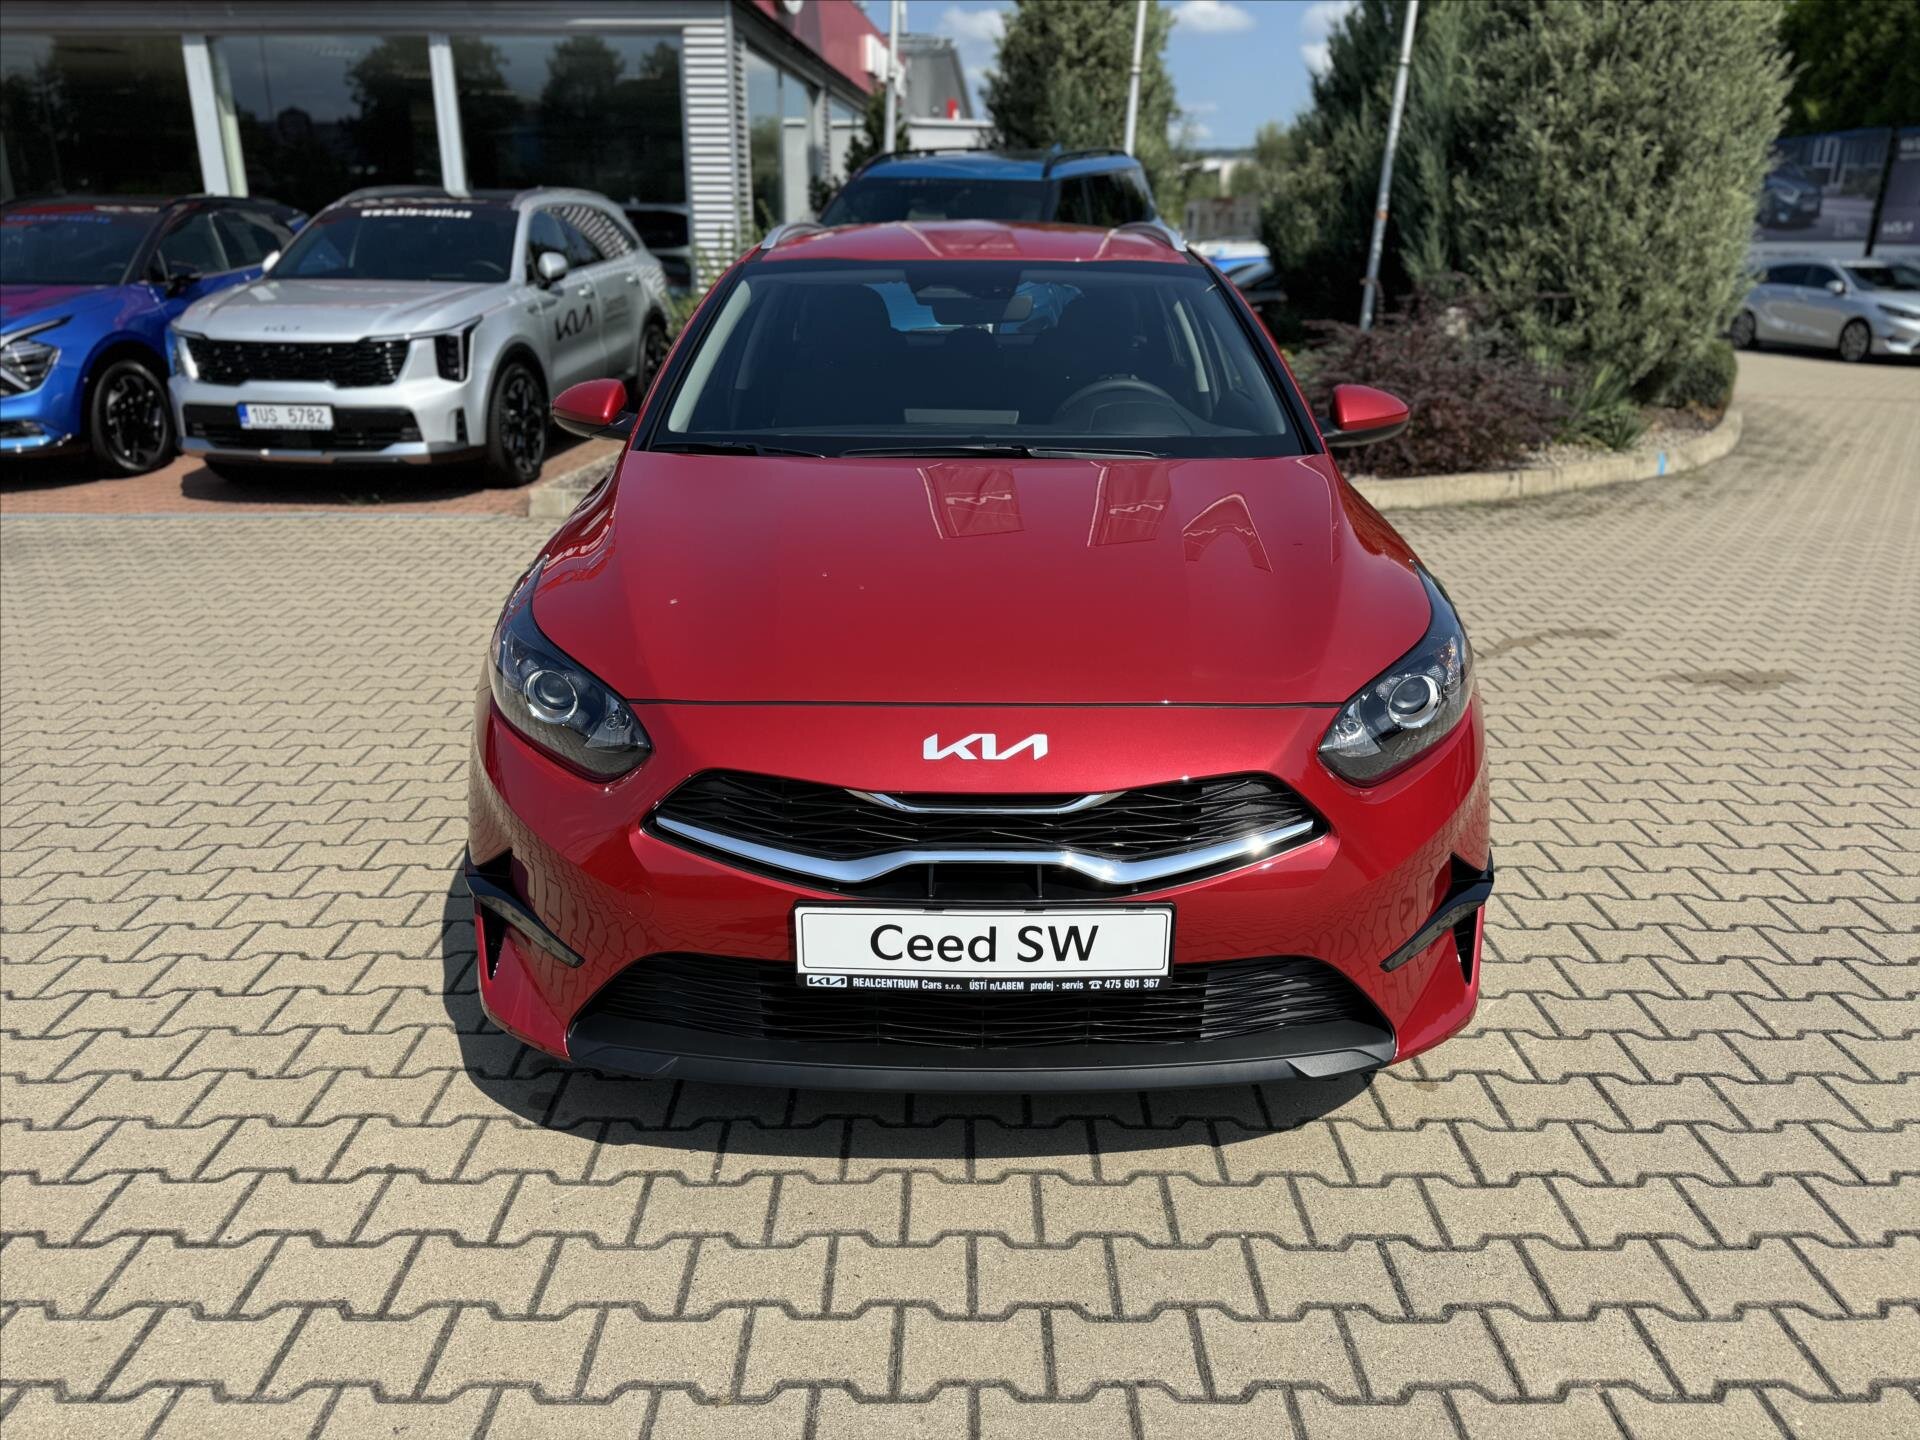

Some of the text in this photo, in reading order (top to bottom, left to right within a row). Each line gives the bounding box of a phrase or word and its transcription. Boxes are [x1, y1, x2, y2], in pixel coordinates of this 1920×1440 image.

[251, 407, 326, 425] 1US 5782
[923, 733, 1048, 760] KIA
[870, 924, 1099, 962] Ceed SW
[808, 976, 846, 987] KIA
[852, 977, 919, 990] REALCENTRUM
[921, 979, 942, 990] Cars
[944, 983, 963, 991] s.r.o.
[969, 979, 987, 991] ÚSTÍ
[989, 980, 1025, 991] n/LABEM
[1030, 980, 1054, 992] prodej
[1061, 980, 1084, 990] servis
[1104, 979, 1121, 989] 475
[1124, 979, 1140, 989] 601
[1143, 978, 1160, 989] 367
